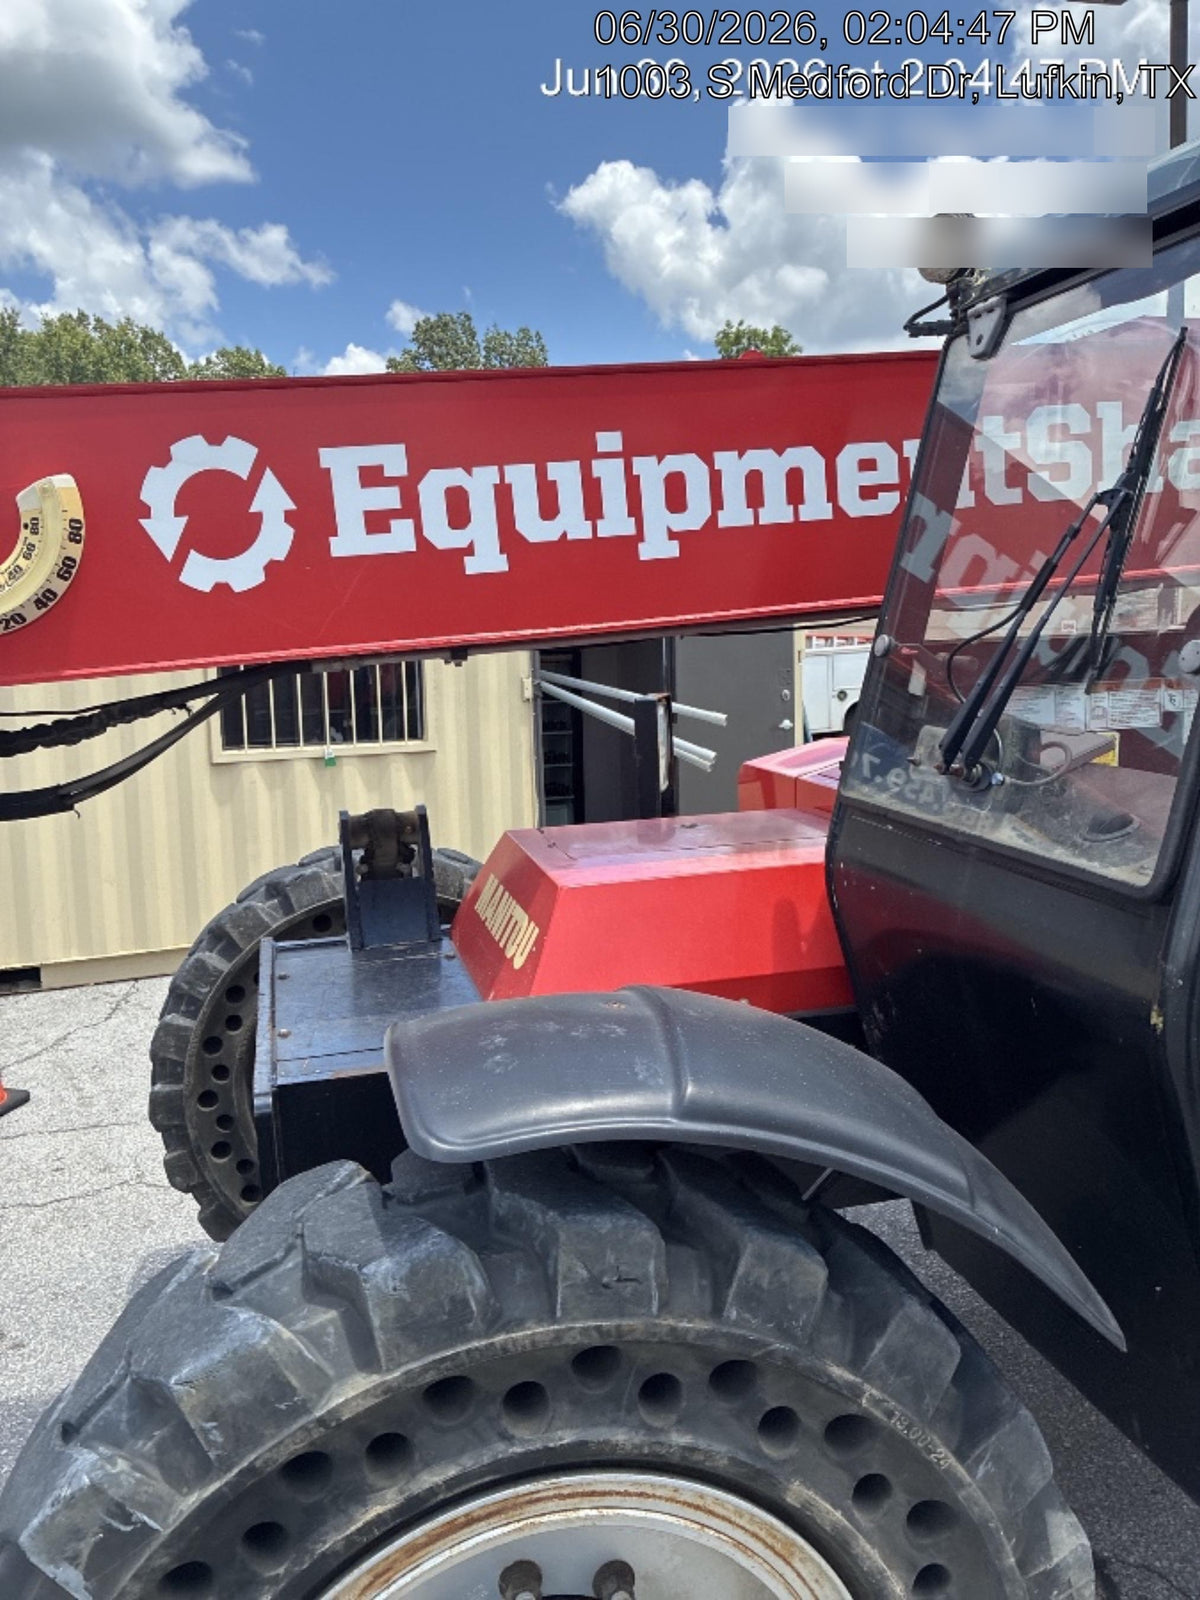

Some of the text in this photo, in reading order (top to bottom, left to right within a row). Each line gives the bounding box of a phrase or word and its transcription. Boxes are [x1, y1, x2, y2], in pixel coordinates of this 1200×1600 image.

[68, 518, 84, 544] 80
[56, 556, 77, 582] 60
[33, 588, 58, 610] 40
[1, 612, 27, 631] 20
[474, 873, 540, 970] MANITOU
